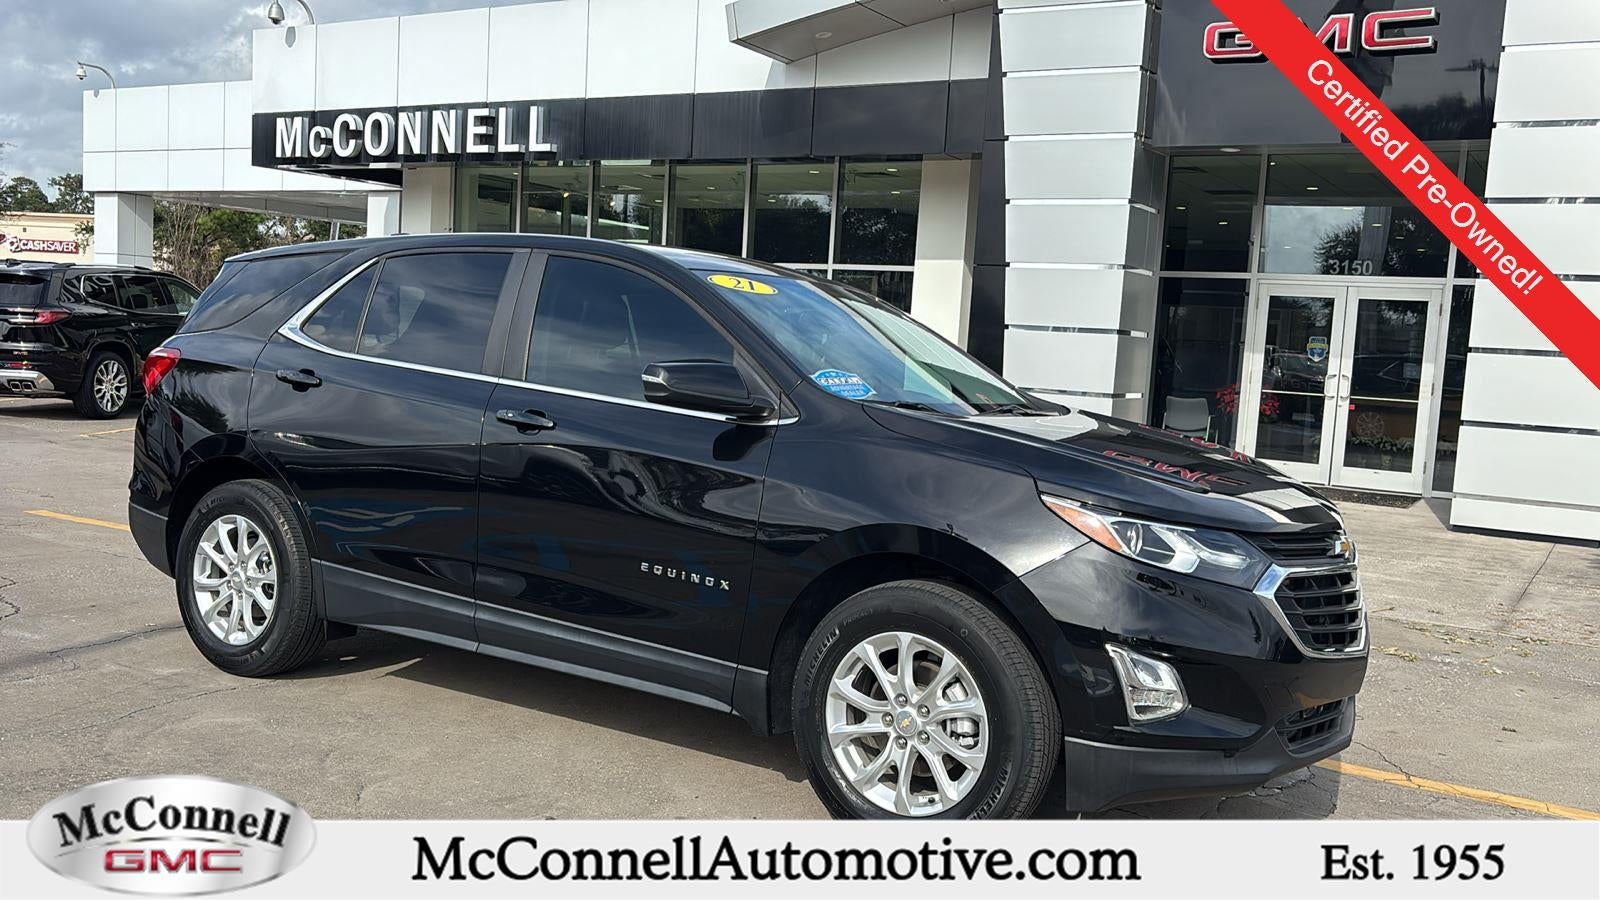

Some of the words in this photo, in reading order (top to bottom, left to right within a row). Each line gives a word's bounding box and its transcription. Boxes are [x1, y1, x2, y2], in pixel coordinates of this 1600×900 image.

[275, 105, 557, 158] McCONNELL
[1328, 259, 1373, 275] 3150
[728, 277, 755, 290] 21
[640, 562, 730, 590] EQUINOX
